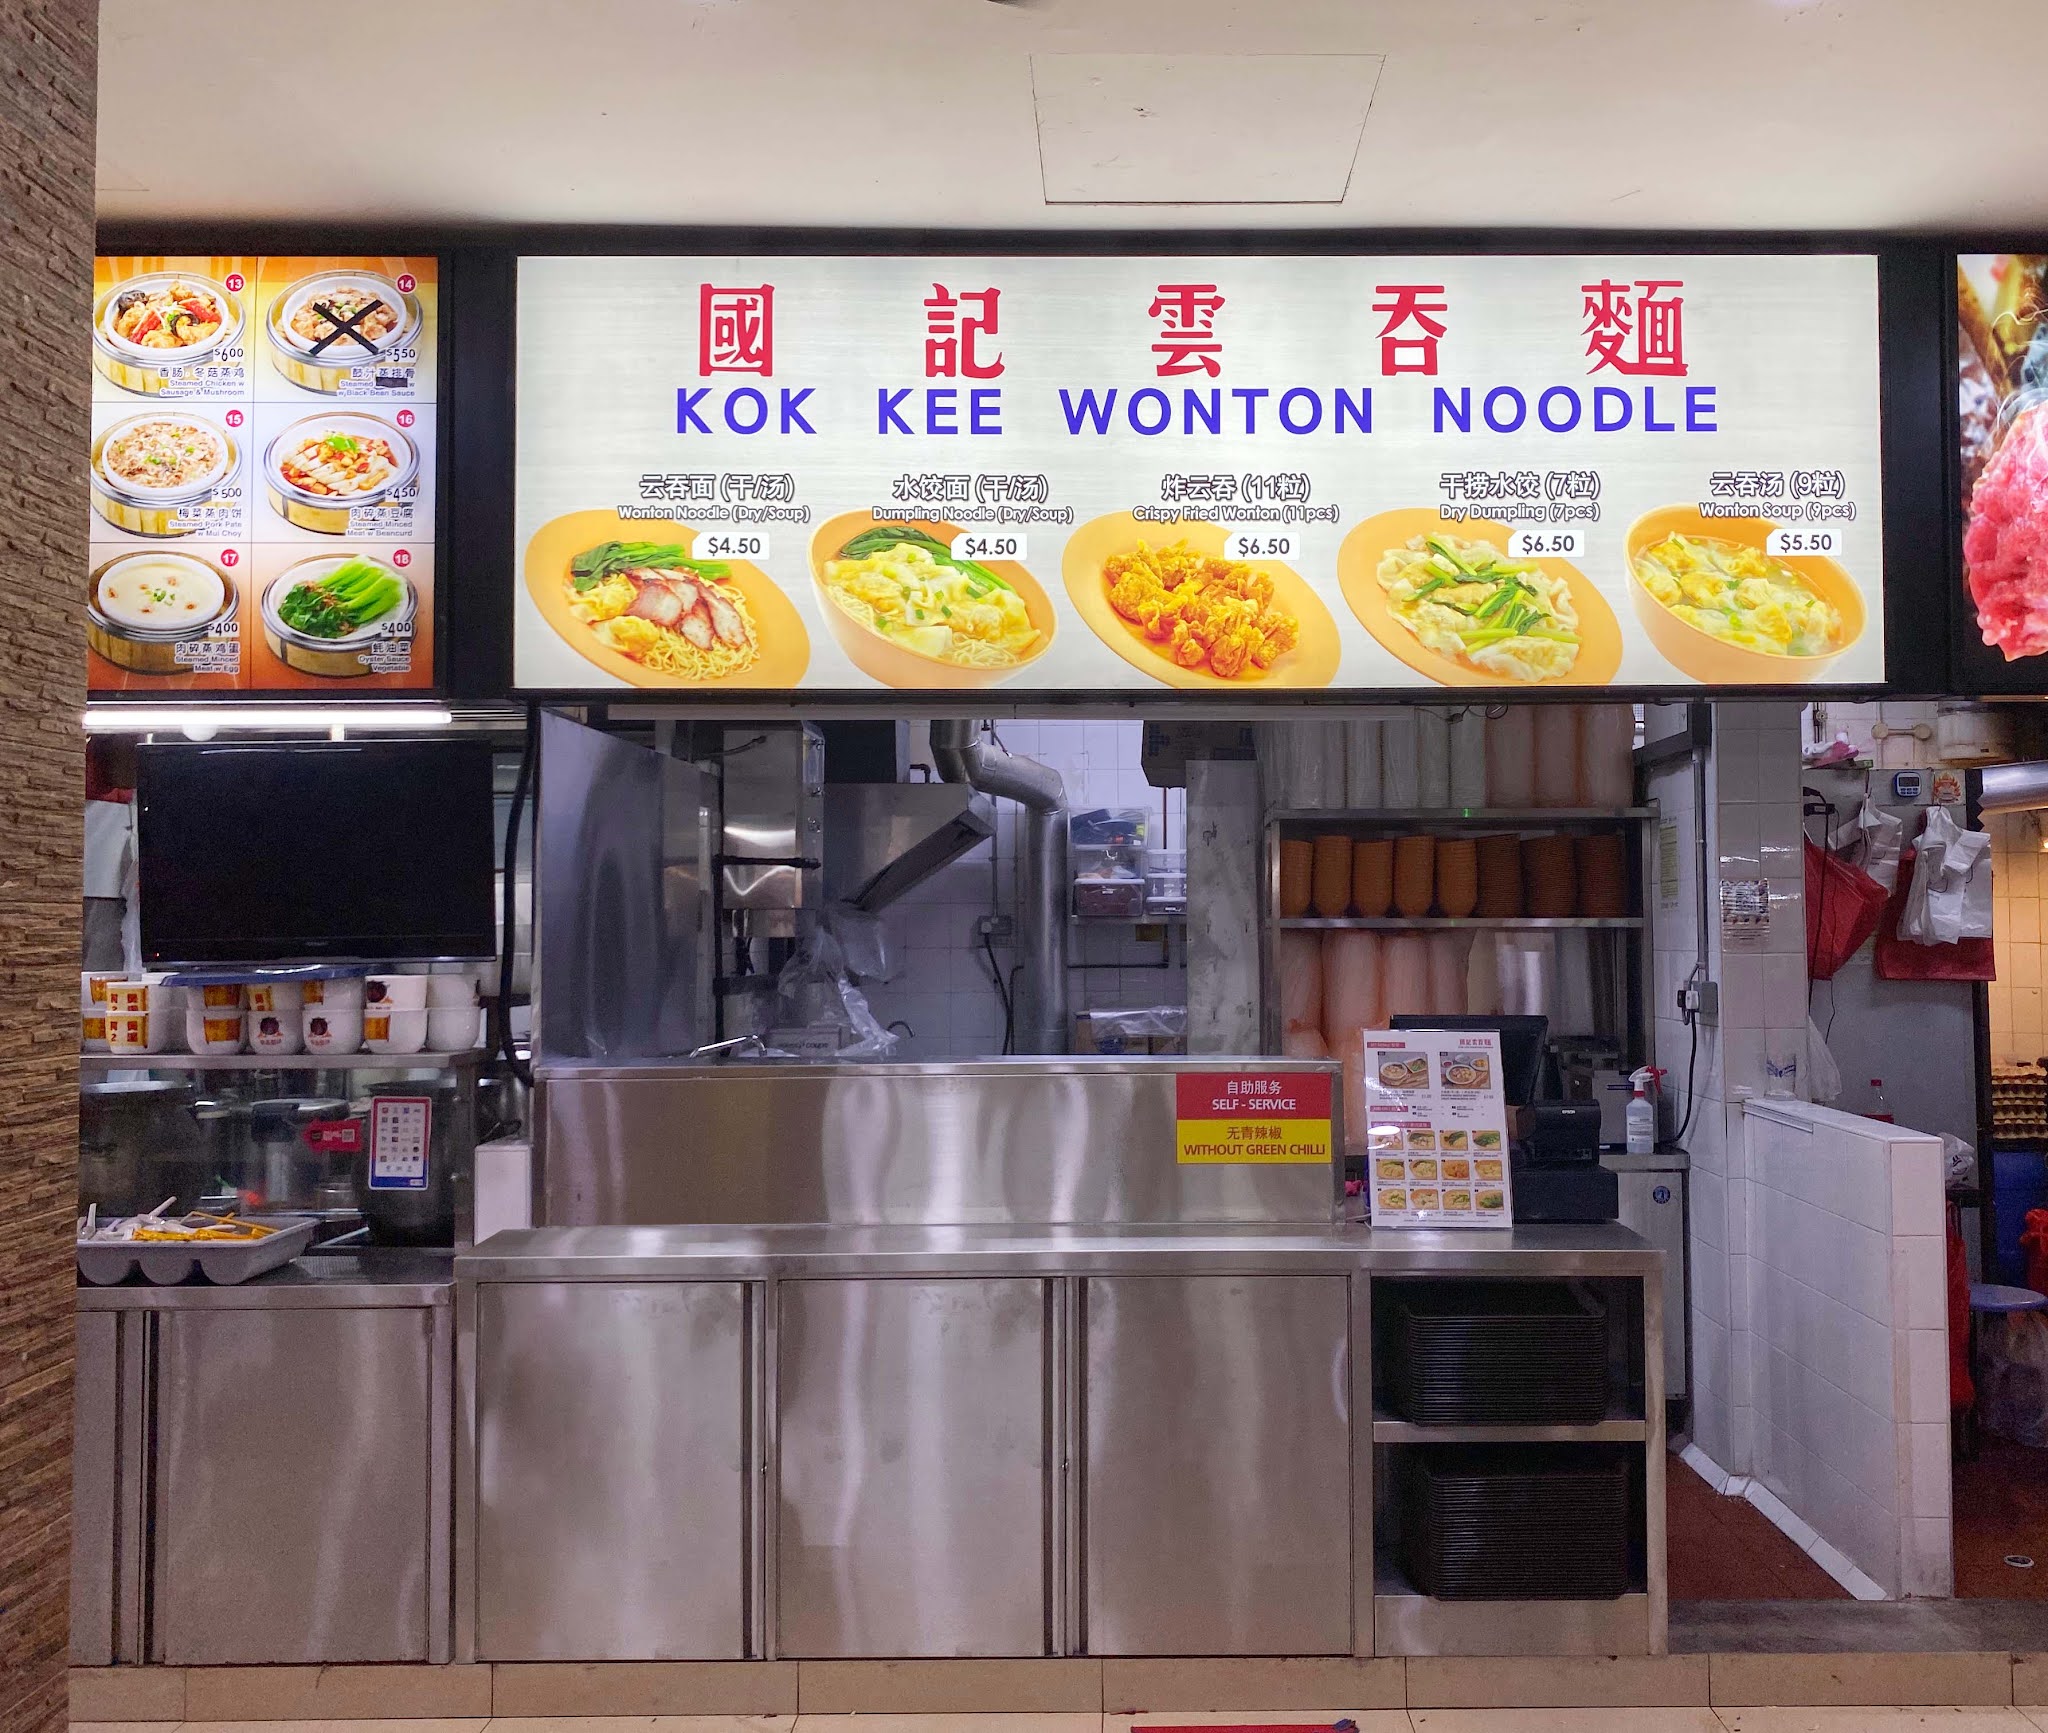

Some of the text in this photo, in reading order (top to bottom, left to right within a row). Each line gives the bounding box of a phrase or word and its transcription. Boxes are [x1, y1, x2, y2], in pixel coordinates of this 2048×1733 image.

[228, 279, 242, 289] 13
[399, 279, 413, 289] 14
[228, 414, 242, 424] 15
[399, 414, 413, 424] 16
[677, 386, 1717, 435] KOK KEE WONTON NOODLE
[640, 473, 795, 502] 云吞面 (干/汤)
[892, 474, 1049, 502] 水饺面 (干/汤)
[1161, 474, 1311, 502] 炸云吞 (11粒)
[1440, 471, 1601, 500] 干捞水饺 (7粒)
[1710, 470, 1845, 499] 云吞汤 (9粒)
[352, 509, 413, 518] 肉碎蒸豆腐
[618, 505, 811, 523] Wonton Noodle (Dry/Soup)
[872, 506, 1073, 524] Dumpling Noodle (Dry/Soup)
[1133, 505, 1339, 523] Crispy Fried Wonton (11pcs)
[1440, 503, 1600, 522] Dry Dumpling (7pcs)
[1699, 502, 1856, 520] Wonton Soup (9pcs)
[708, 536, 761, 556] $4.50
[965, 537, 1017, 557] $4.50
[1238, 537, 1290, 557] $6.50
[1522, 534, 1575, 554] $6.50
[1780, 533, 1832, 553] $5.50
[223, 553, 237, 564] 17
[396, 553, 409, 564] 18
[359, 655, 384, 663] Oyster
[1227, 1080, 1282, 1095] 自助服务
[1212, 1099, 1239, 1110] SELF
[1248, 1099, 1296, 1110] SERVICE
[1226, 1126, 1282, 1140] 无青辣椒
[1184, 1144, 1325, 1156] WITHOUT GREEN CHILLI
